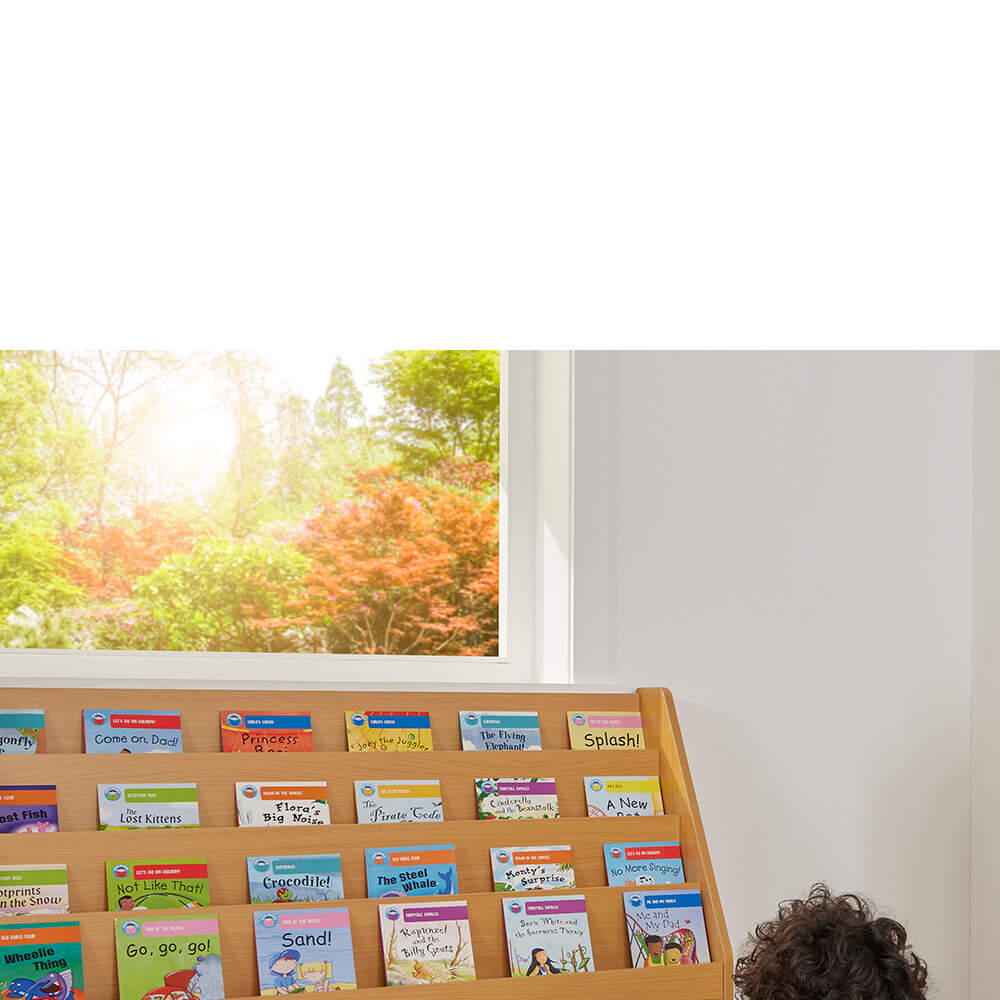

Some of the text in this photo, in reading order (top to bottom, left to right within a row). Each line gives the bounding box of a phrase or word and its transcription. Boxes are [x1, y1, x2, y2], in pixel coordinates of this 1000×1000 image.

[95, 734, 127, 745] Come
[152, 735, 179, 747] Dad!
[241, 733, 298, 745] Princess
[357, 736, 429, 751] Joey the Juggler
[480, 731, 526, 742] The Flying
[584, 732, 640, 750] Splash!
[275, 802, 321, 816] Flora's
[490, 796, 531, 809] Cinderella
[606, 797, 648, 811] A New
[22, 809, 48, 821] Fish
[120, 813, 182, 824] Lost Kittens
[262, 813, 325, 824] Big Noise
[370, 807, 441, 823] Pirate Code
[505, 866, 546, 880] Monty's
[611, 862, 681, 877] No More Singing!
[263, 875, 331, 890] Crocodile!
[377, 868, 428, 886] The Steel
[520, 874, 565, 887] Surprise
[117, 880, 204, 895] Not Like That!
[402, 878, 437, 893] Whale
[11, 896, 26, 908] the
[30, 895, 62, 907] Snow
[636, 909, 669, 921] Me and
[400, 925, 448, 939] Rapunzel
[645, 918, 680, 932] My Dad
[281, 931, 332, 948] Sand!
[126, 939, 210, 958] Go, go, go!
[401, 943, 454, 959] Billy Goats
[4, 947, 55, 965] Wheelie
[33, 957, 67, 972] Thing
